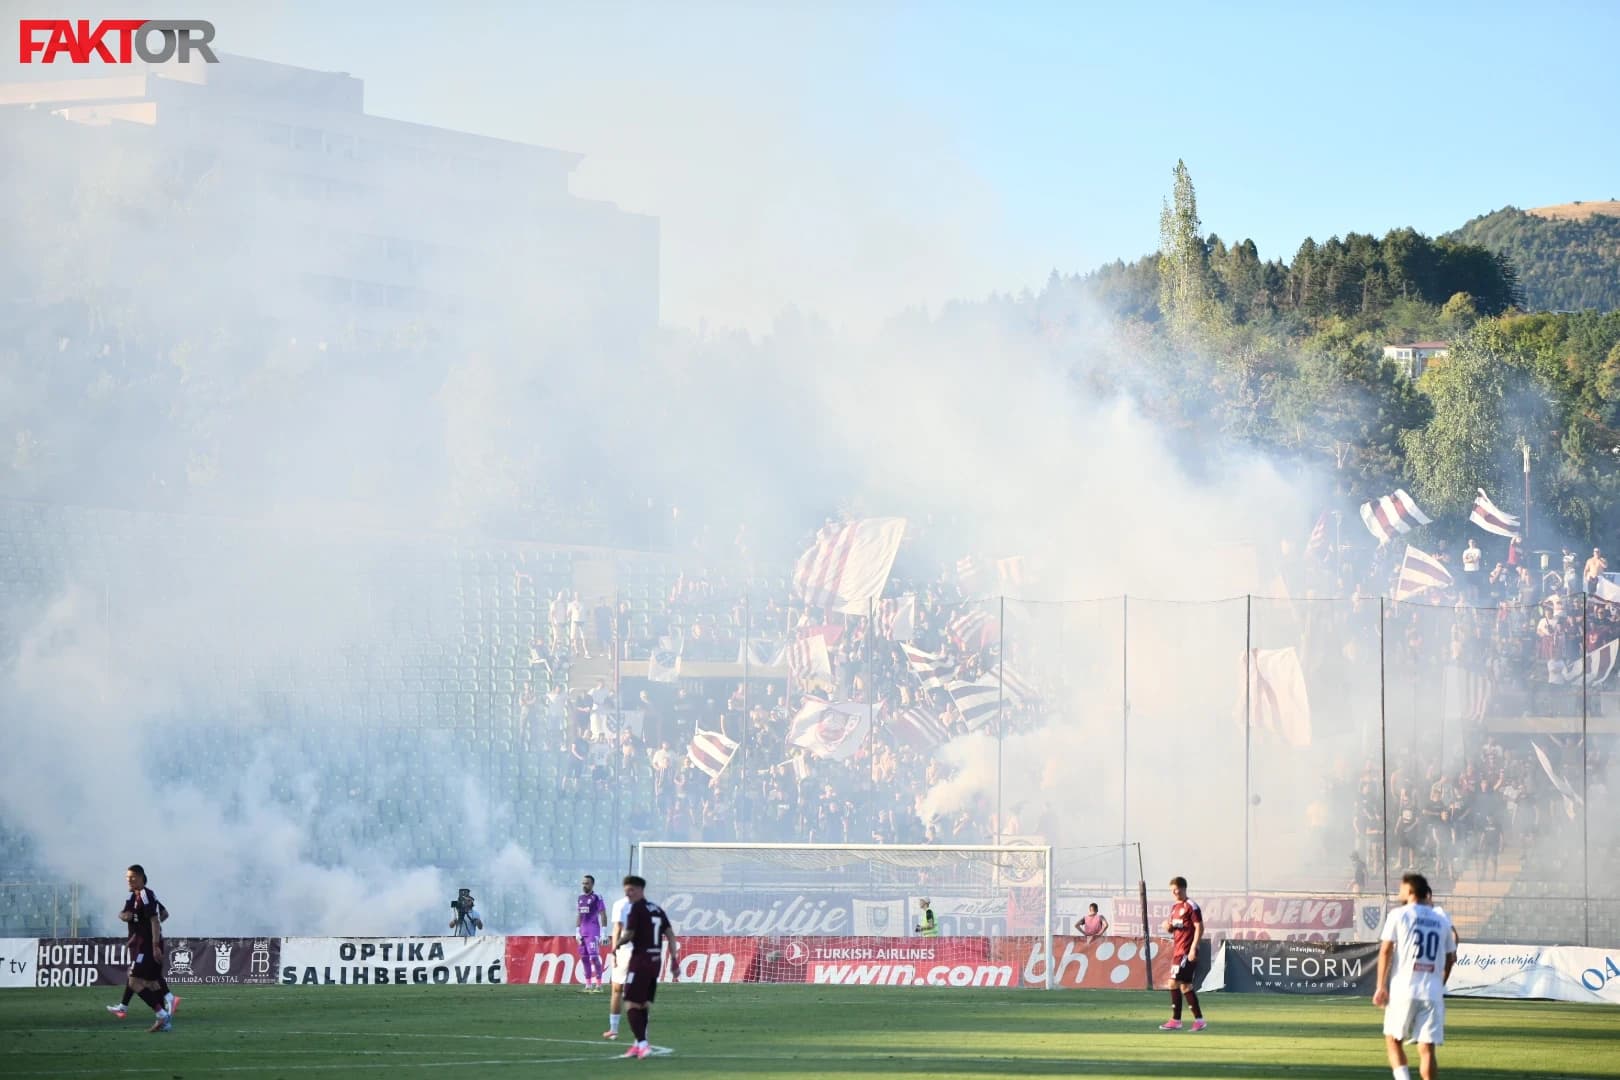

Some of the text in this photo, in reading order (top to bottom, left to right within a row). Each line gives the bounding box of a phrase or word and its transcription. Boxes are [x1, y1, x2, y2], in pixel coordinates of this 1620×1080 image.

[1200, 896, 1343, 927] ARAJEVO
[651, 916, 662, 945] 7
[39, 944, 132, 965] HOTELI ILI
[340, 942, 444, 961] OPTIKA
[816, 948, 935, 960] TURKISH AIRLINES
[1412, 928, 1440, 961] 30
[9, 958, 27, 974] tv
[282, 959, 502, 984] SALIHBEGOVIĆ
[1251, 956, 1362, 977] REFORM
[1473, 954, 1498, 970] koja
[1500, 953, 1543, 970] osvaja!
[38, 967, 98, 987] GROUP
[205, 975, 239, 983] CRYSTAL
[813, 964, 1013, 987] wwin.com
[1255, 980, 1357, 989] www.reform.ba
